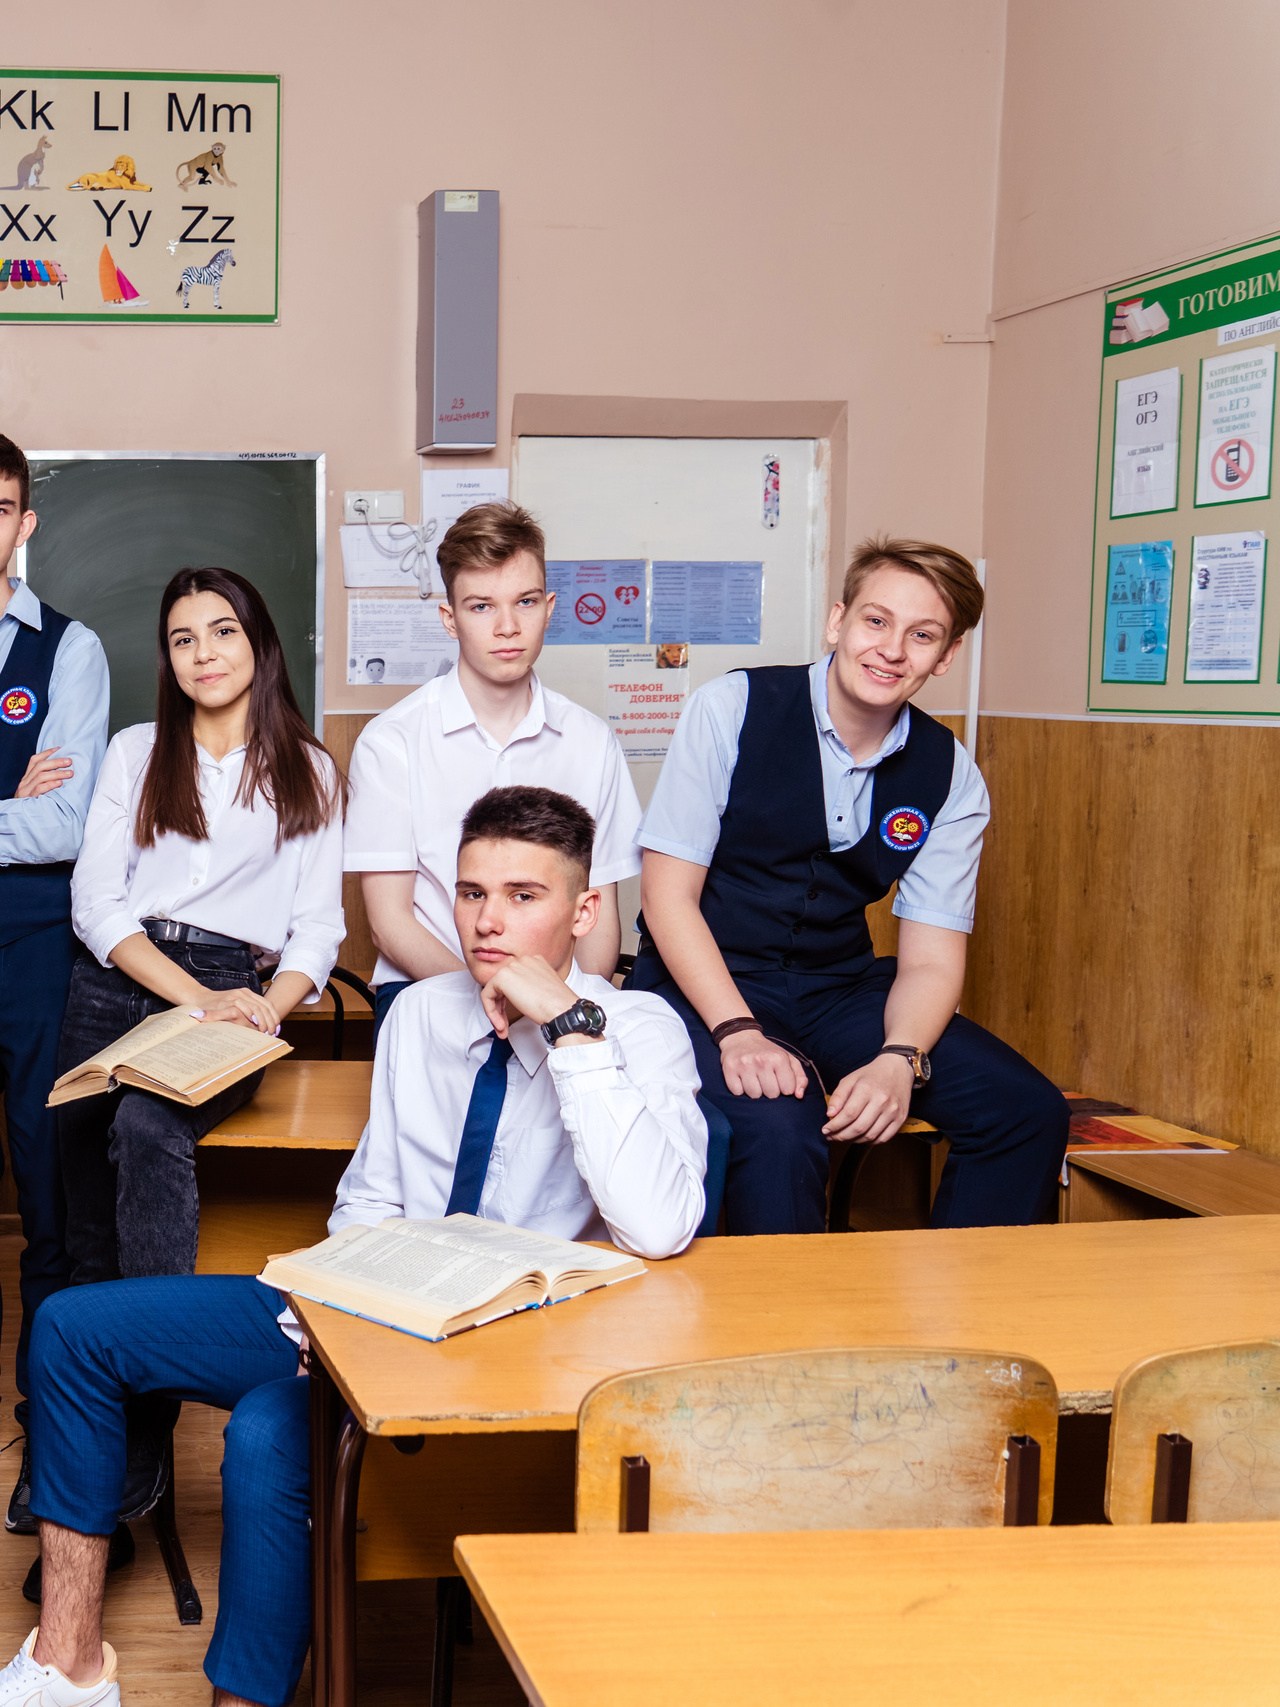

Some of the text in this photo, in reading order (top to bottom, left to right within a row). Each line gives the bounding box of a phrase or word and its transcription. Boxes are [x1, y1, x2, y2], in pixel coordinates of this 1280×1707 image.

[94, 91, 129, 131] Ll
[168, 93, 251, 133] Mm
[93, 200, 152, 247] Yy
[179, 206, 235, 243] Zz
[1205, 368, 1268, 391] ЗАПРЕЩАЕТСЯ
[451, 398, 464, 410] 23
[1137, 391, 1158, 407] ЕГЭ
[1229, 397, 1250, 411] ЕГЭ
[1136, 410, 1158, 426] ОГЭ
